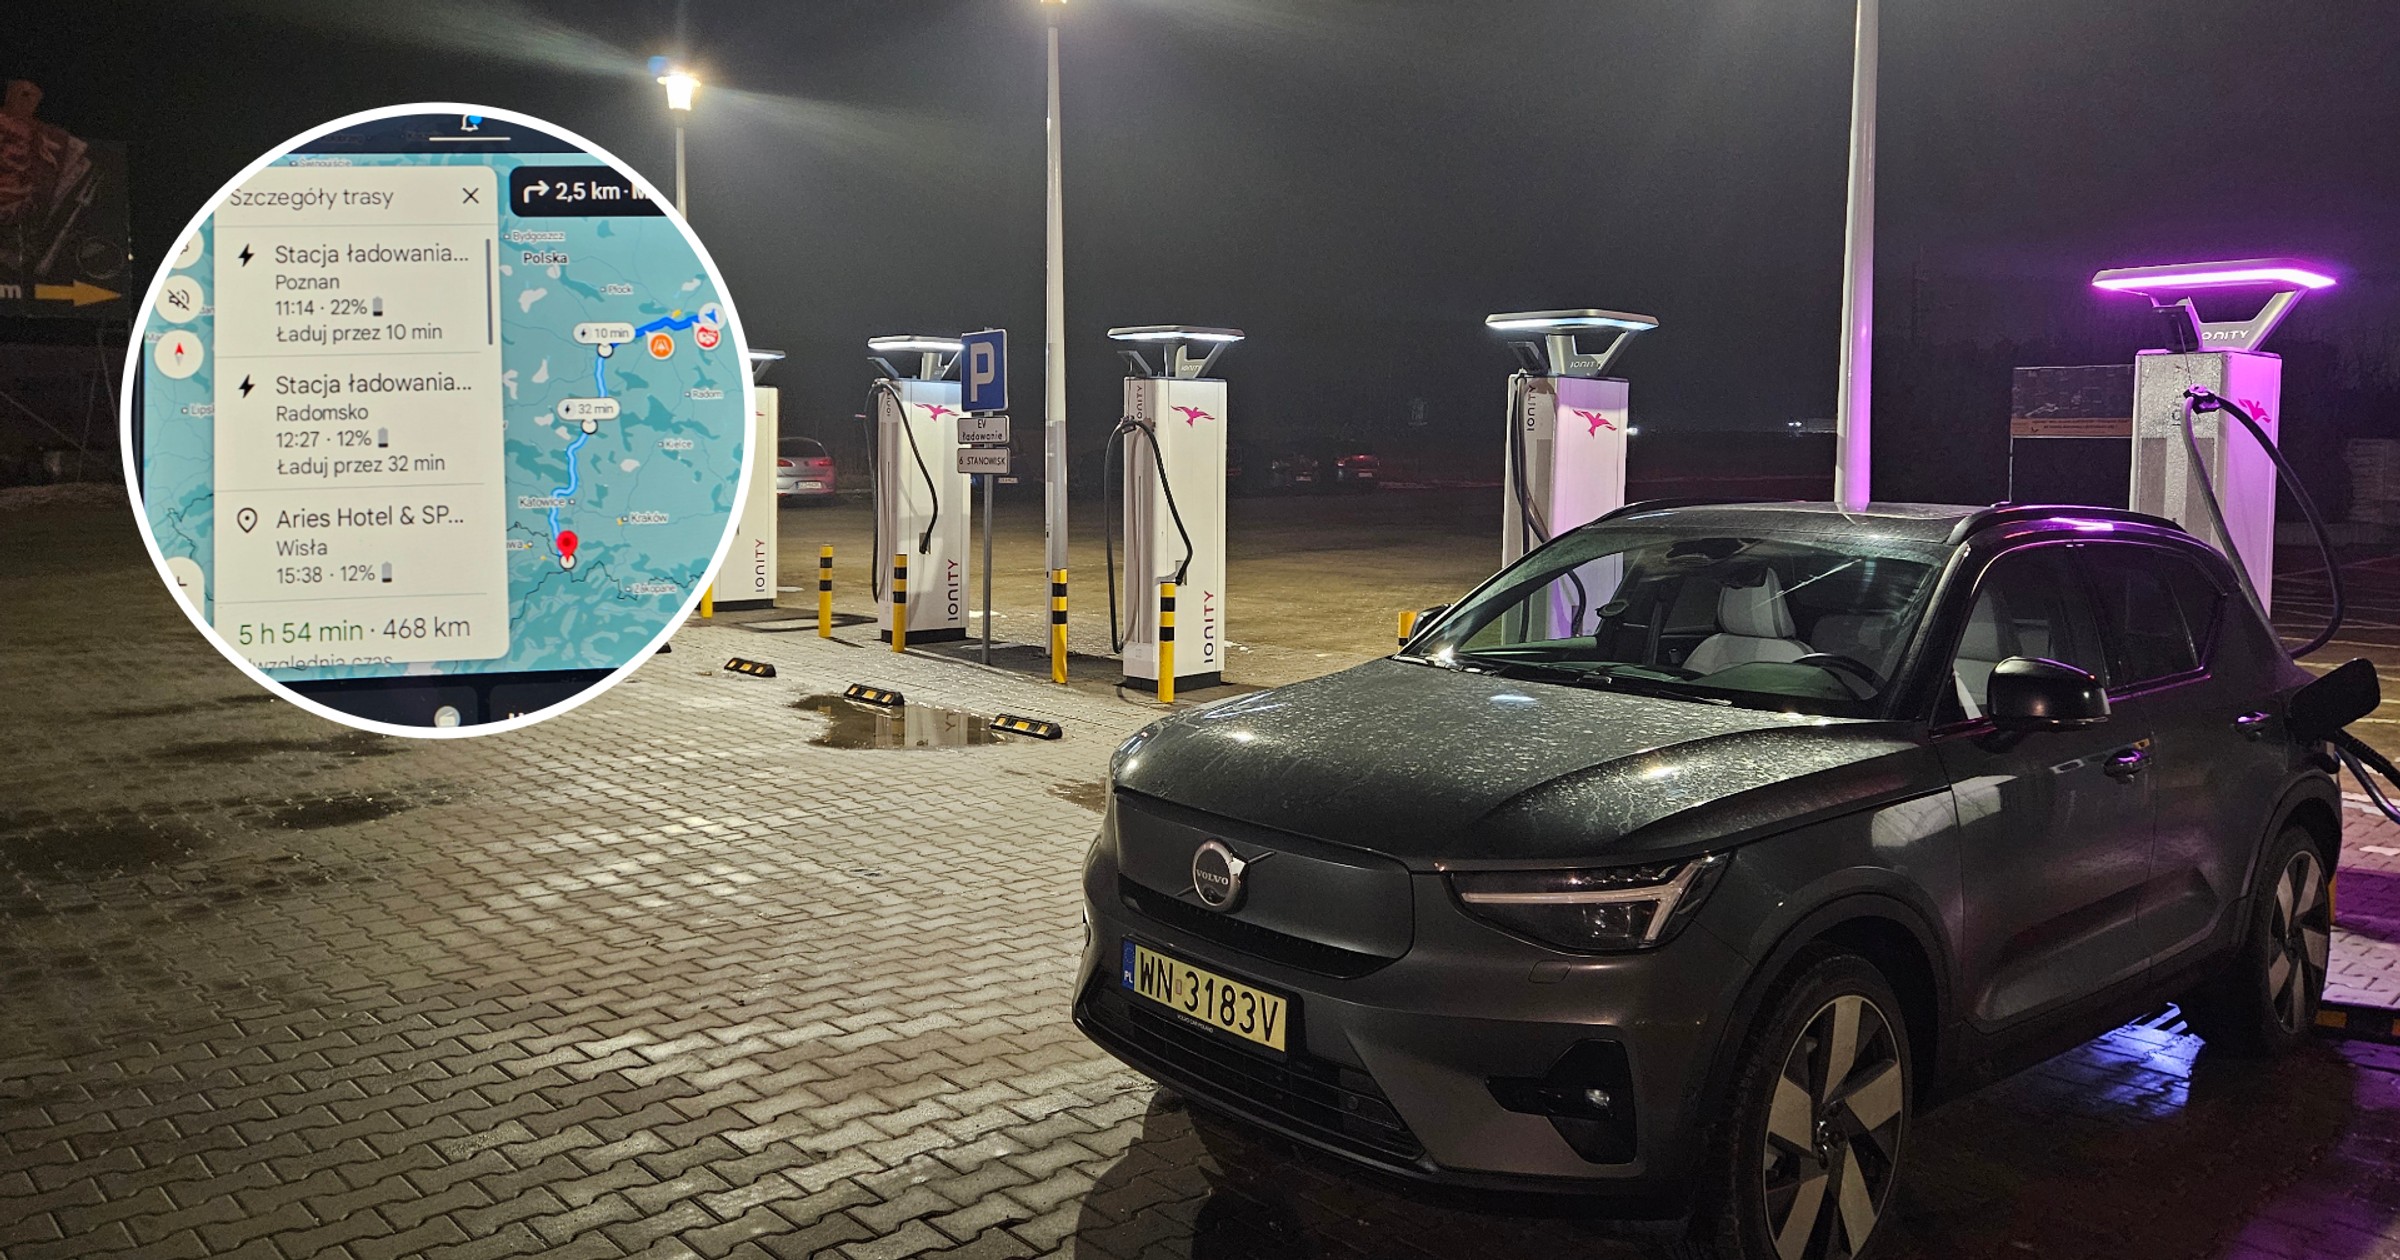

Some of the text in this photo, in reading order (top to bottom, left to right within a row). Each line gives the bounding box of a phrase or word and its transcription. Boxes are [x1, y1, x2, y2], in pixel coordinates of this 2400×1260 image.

[230, 186, 394, 210] Szczegóły trasy
[555, 182, 586, 202] 2,5
[591, 182, 620, 200] km
[512, 231, 564, 242] Bydgoszcz
[275, 242, 469, 267] Stacja ładowania...
[523, 252, 568, 264] Polska
[275, 274, 340, 290] Poznan
[275, 299, 368, 316] 11:14 22%
[276, 322, 442, 345] Ładuj przez 10 min
[594, 328, 630, 338] 10 min
[2202, 330, 2248, 340] ONITY
[970, 342, 994, 402] P
[276, 372, 472, 396] Stacja ładowania...
[692, 390, 723, 399] Radom
[276, 404, 369, 422] Radomsko
[578, 403, 614, 414] 32 min
[1526, 385, 1536, 432] IONITY
[978, 419, 986, 429] EV
[276, 429, 372, 449] 12:27 12%
[962, 430, 1002, 441] ładowanie
[664, 440, 692, 450] Kielce
[276, 455, 446, 479] Ładuj przez 32 min
[959, 456, 1006, 466] 6 STANOWISK
[518, 496, 566, 508] Katowice
[276, 509, 330, 529] Aries
[338, 506, 393, 528] Hotel
[400, 506, 415, 525] &
[630, 512, 668, 524] Kraków
[276, 540, 328, 557] Wisła
[276, 565, 376, 584] 15:38 12%
[755, 538, 765, 593] IONITY
[633, 584, 676, 596] Zakopane
[947, 558, 960, 622] IONITY
[238, 616, 470, 645] 5 h 54 min 468 km
[1202, 589, 1216, 664] IONITY
[1196, 868, 1229, 886] VOLVO
[1123, 970, 1133, 984] PL
[1140, 951, 1278, 1042] WN 3183V
